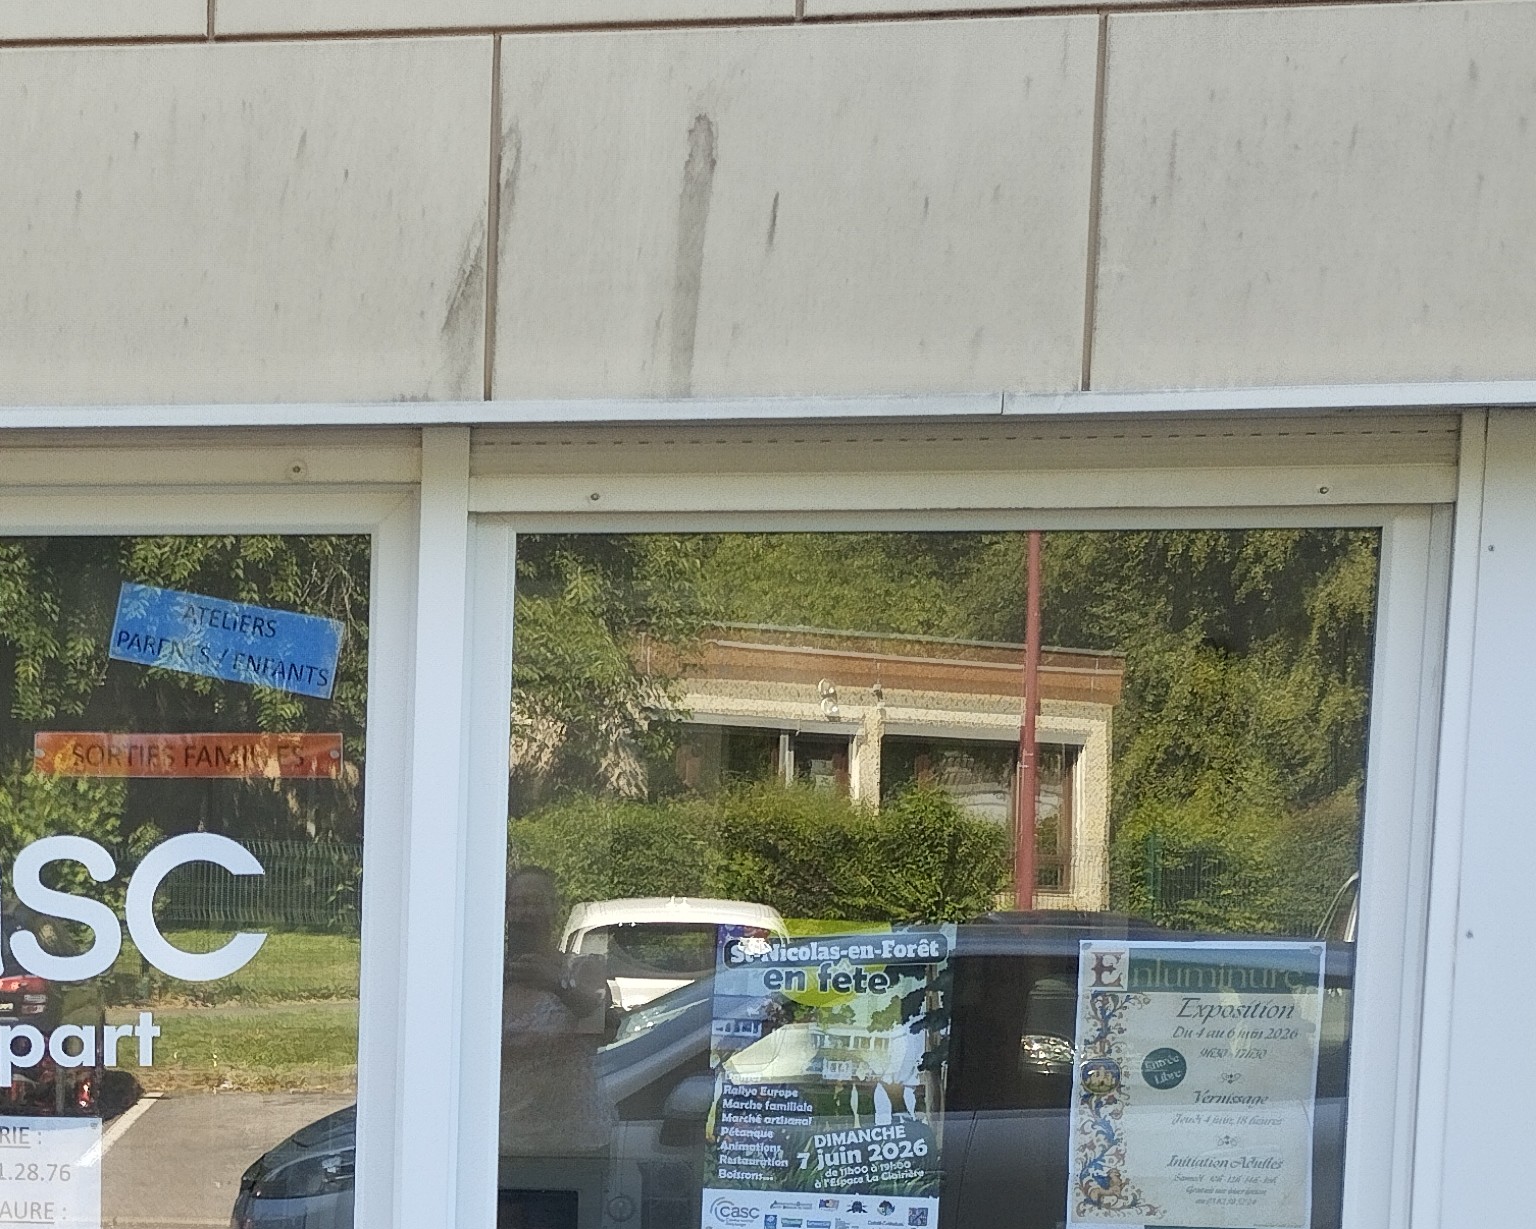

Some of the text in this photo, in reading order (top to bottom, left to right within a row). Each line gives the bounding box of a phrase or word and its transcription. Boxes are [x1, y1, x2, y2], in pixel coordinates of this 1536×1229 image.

[183, 606, 278, 639] ATELIERS
[232, 653, 329, 687] ENFANTS
[72, 743, 176, 767] SORTIES
[763, 960, 890, 994] en fête
[1175, 997, 1295, 1024] Exposition
[760, 1086, 799, 1099] Europe
[720, 1126, 774, 1139] Pétanque
[813, 1125, 907, 1149] DIMANCHE
[720, 1140, 782, 1153] Animations
[796, 1138, 928, 1171] 7 juin 2026
[824, 1169, 838, 1178] de
[719, 1206, 760, 1220] casc
